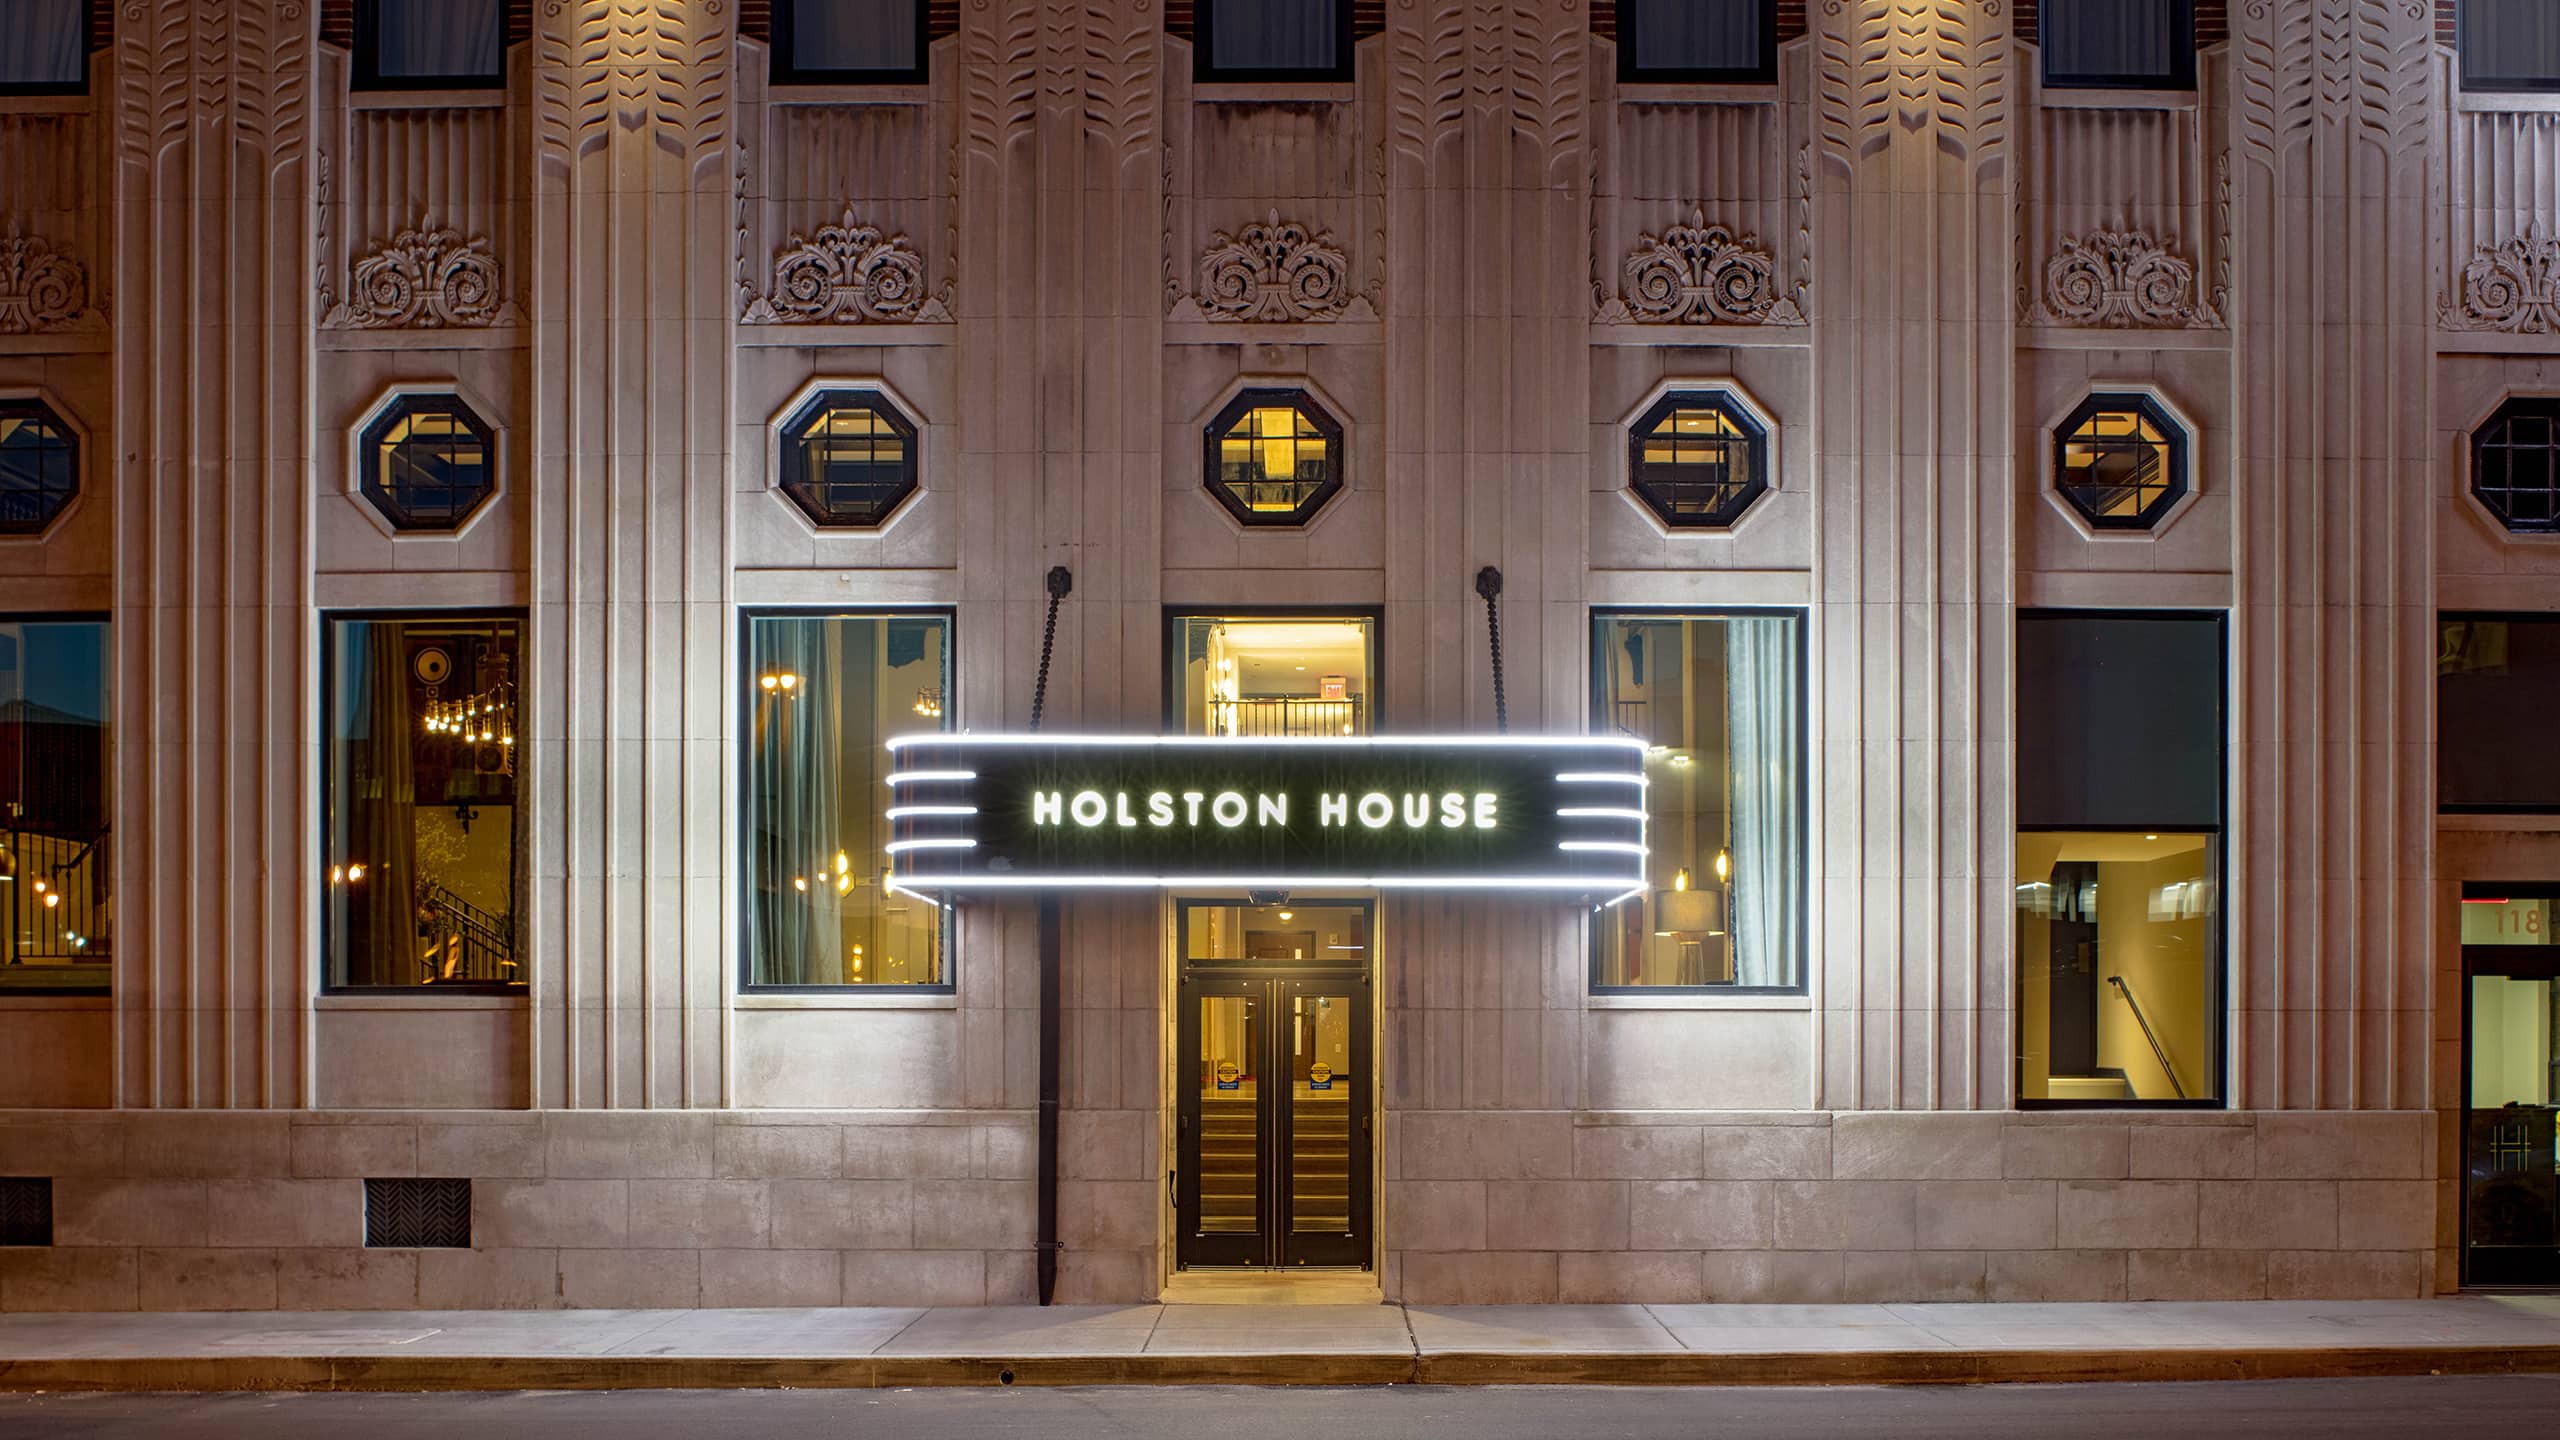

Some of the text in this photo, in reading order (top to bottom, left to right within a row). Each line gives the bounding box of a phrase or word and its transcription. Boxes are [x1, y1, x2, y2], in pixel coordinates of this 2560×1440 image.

[1325, 684, 1343, 697] EXIT
[1034, 790, 1497, 828] HOLSTON HOUSE
[2495, 909, 2542, 934] 118
